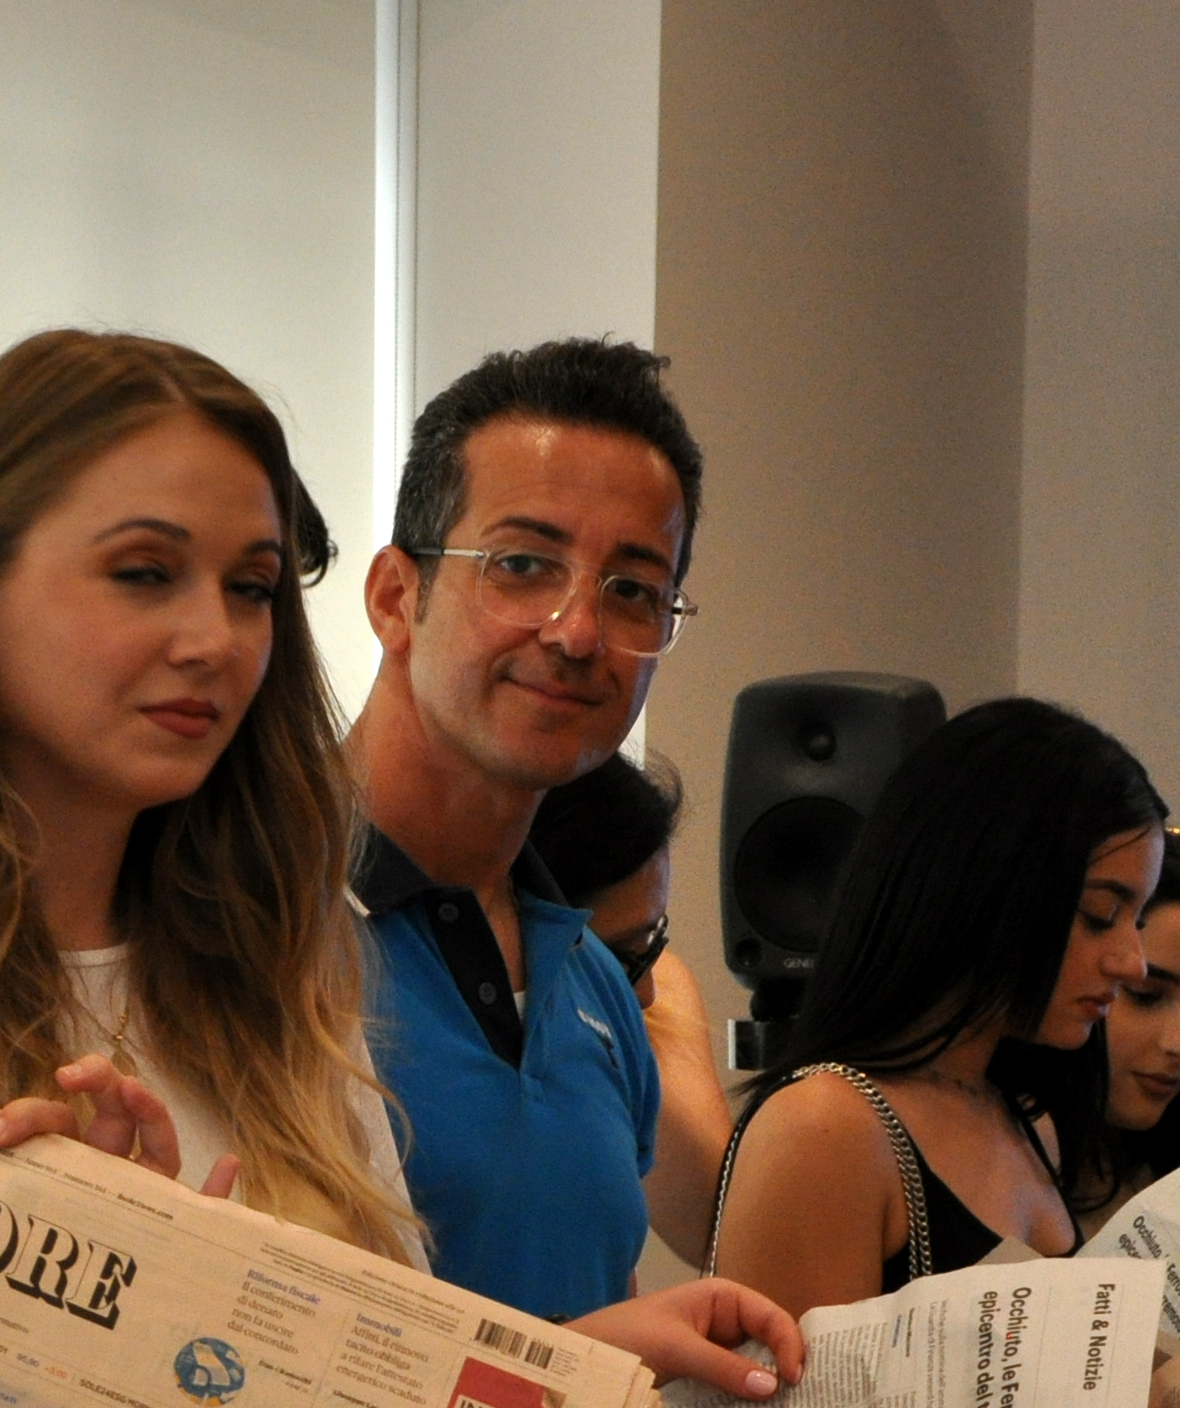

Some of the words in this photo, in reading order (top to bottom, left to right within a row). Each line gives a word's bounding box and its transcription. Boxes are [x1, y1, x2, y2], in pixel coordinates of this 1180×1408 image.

[1093, 1283, 1116, 1315] Fatti
[356, 1312, 402, 1338] Immobili
[977, 1291, 1001, 1370] epicentro
[1002, 1287, 1032, 1363] Occhiuto,
[1091, 1319, 1109, 1331] &
[1001, 1363, 1022, 1382] le
[1083, 1336, 1107, 1390] Notizie
[975, 1372, 995, 1401] del
